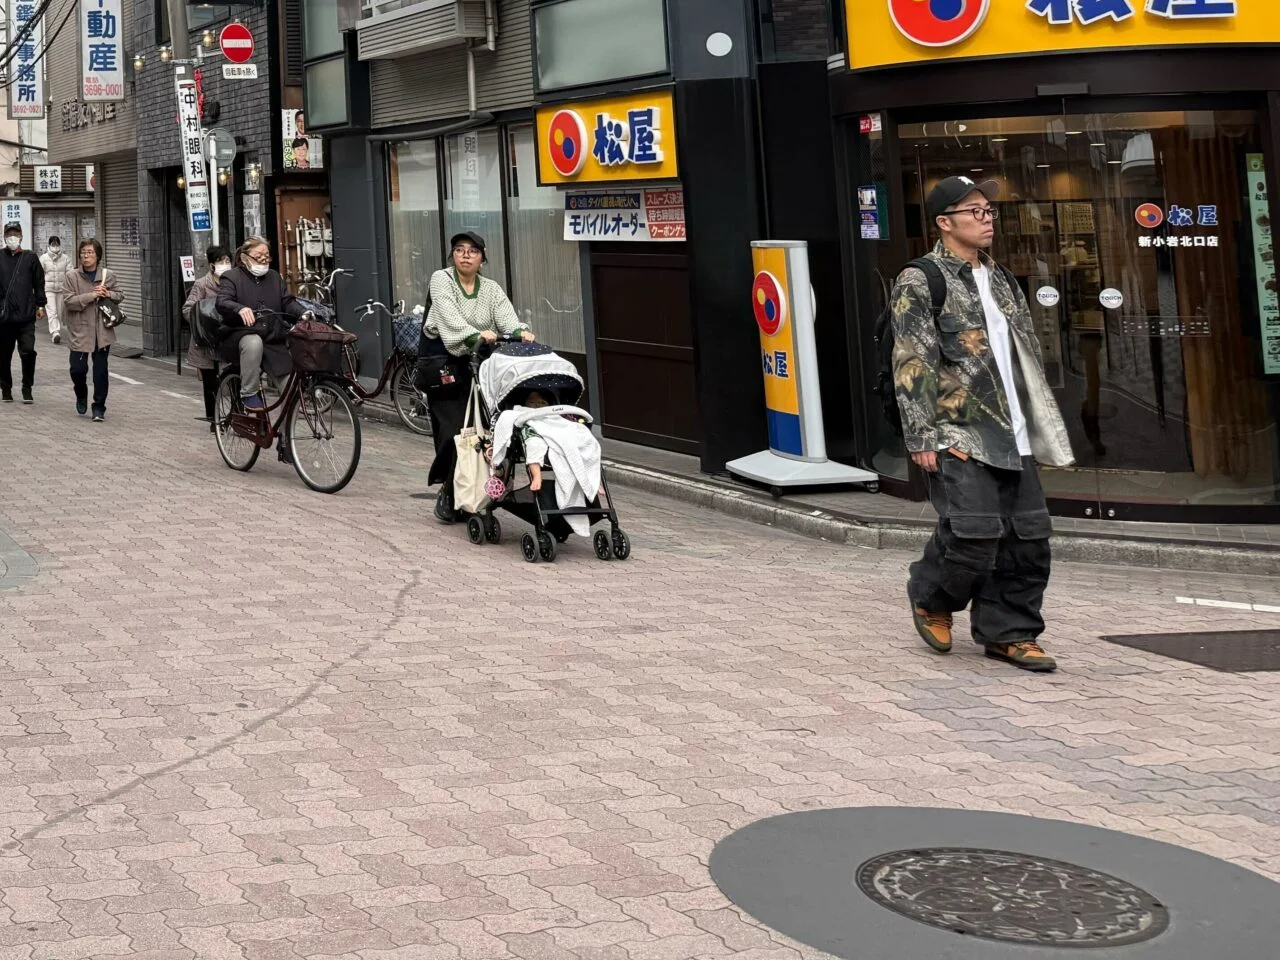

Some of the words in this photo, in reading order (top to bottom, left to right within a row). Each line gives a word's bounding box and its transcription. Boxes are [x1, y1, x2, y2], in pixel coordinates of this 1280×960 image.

[225, 68, 256, 77] 自転車を除く
[84, 84, 122, 96] 3696-0001
[184, 87, 203, 179] 中村眼科
[593, 107, 663, 166] 松屋
[39, 169, 58, 178] 株式
[39, 180, 59, 189] 会社
[1168, 204, 1219, 226] 松屋
[569, 212, 645, 236] モバイルオーダー
[1138, 236, 1219, 247] 新小岩北口店
[763, 349, 789, 378] 松屋
